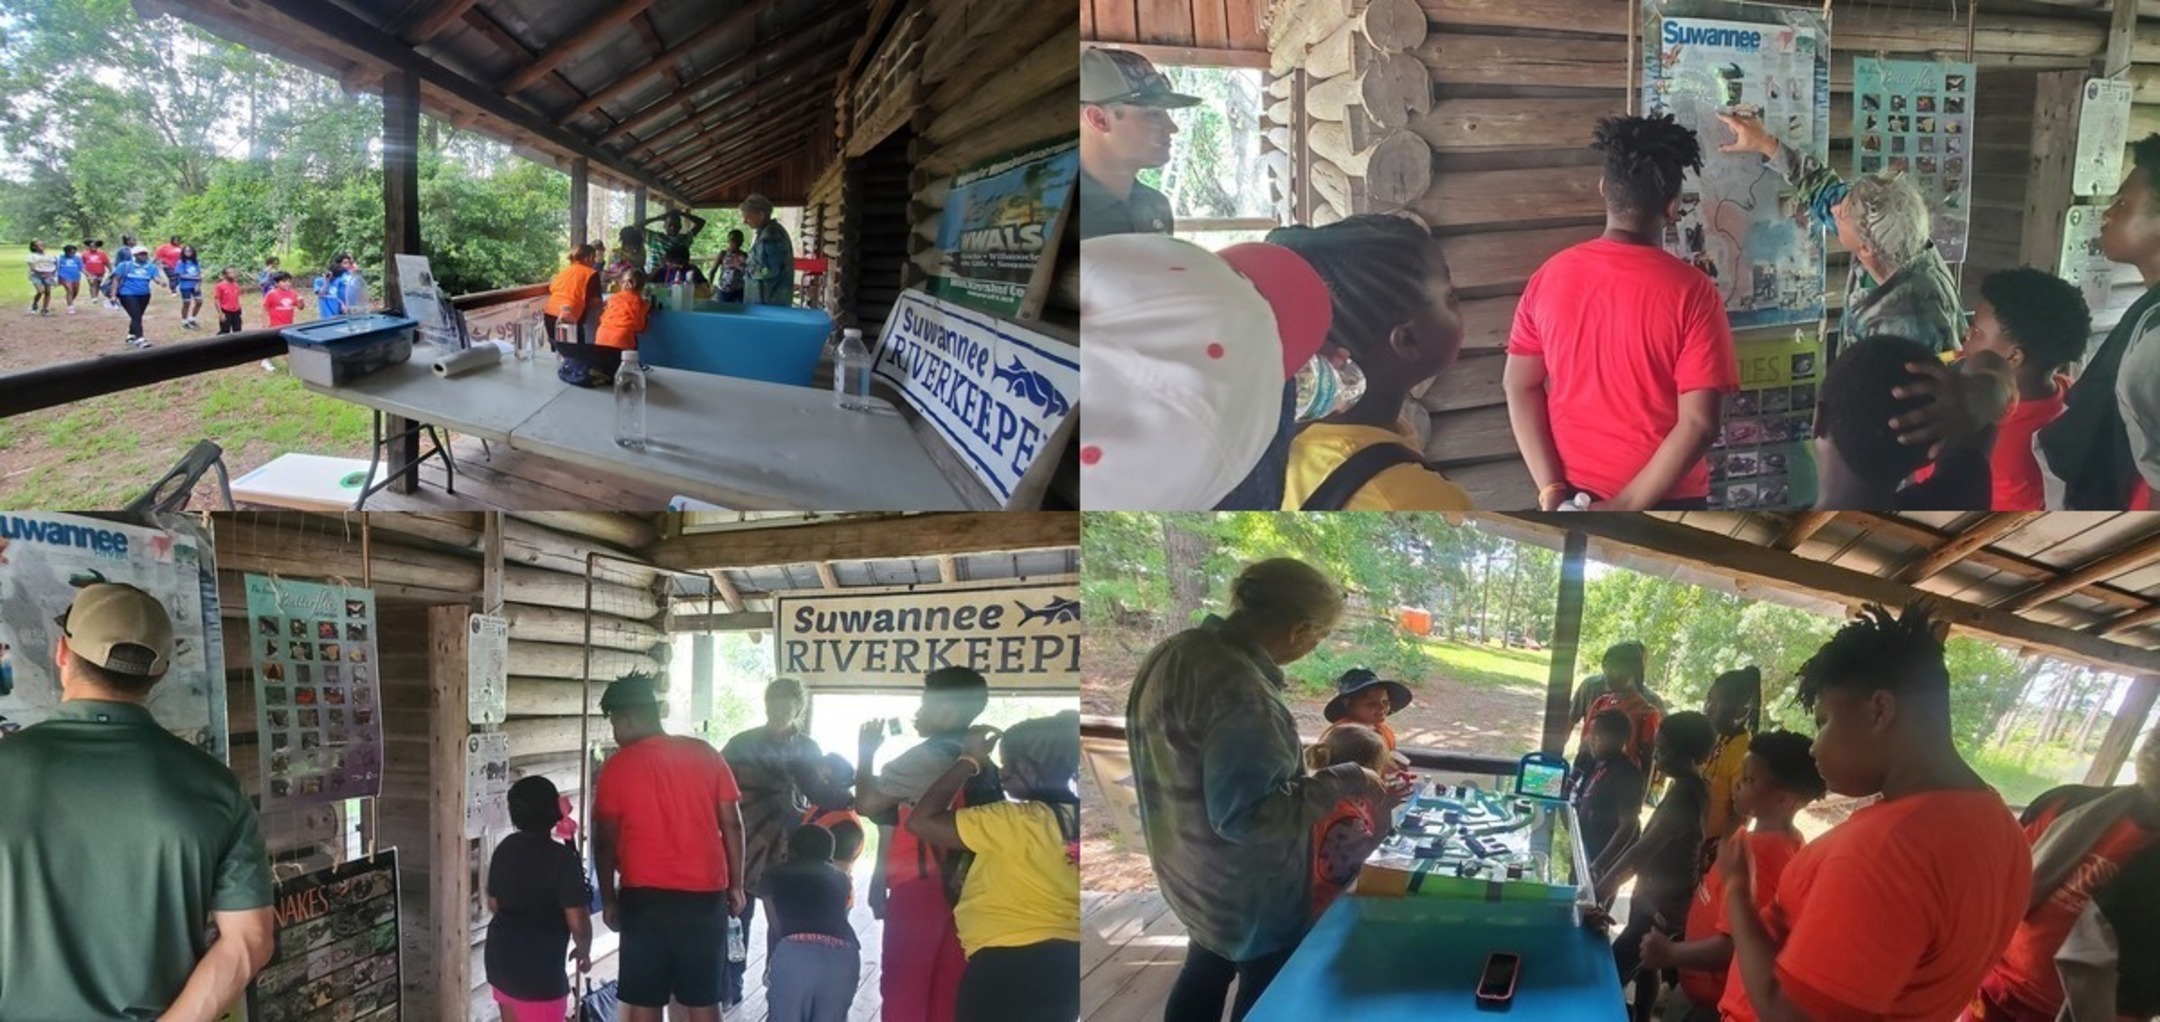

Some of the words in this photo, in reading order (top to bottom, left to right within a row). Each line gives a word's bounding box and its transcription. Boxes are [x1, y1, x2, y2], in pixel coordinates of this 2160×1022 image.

[1663, 20, 1761, 48] Suwannee
[903, 306, 989, 378] Suwannee
[1738, 356, 1780, 384] LES
[887, 334, 1048, 478] RIVERKEEPE
[0, 516, 128, 553] uwannee
[794, 603, 1005, 633] Suwannee
[273, 886, 329, 927] NAKES
